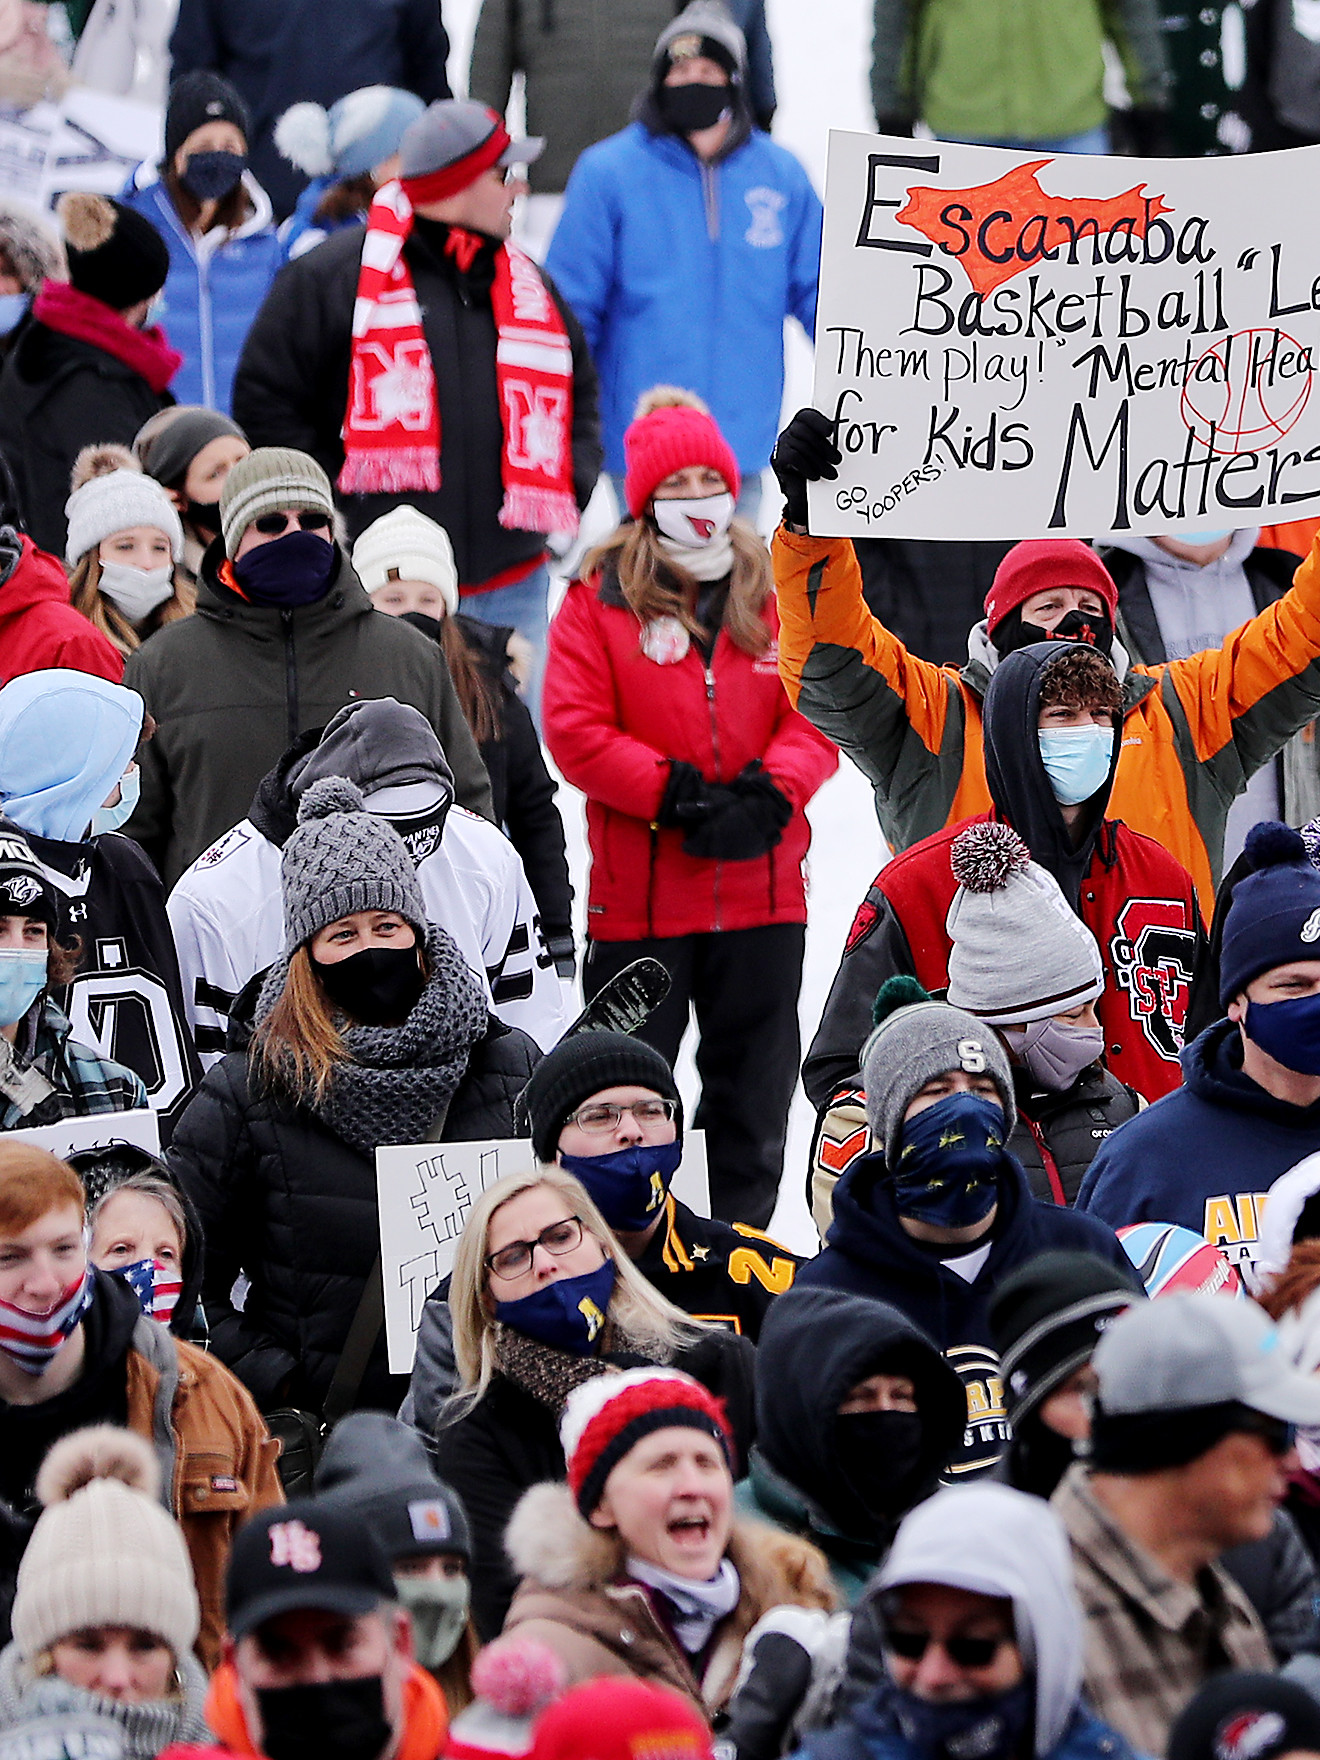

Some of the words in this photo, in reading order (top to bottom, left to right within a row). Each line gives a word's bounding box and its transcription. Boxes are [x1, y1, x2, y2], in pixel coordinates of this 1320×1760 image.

[855, 153, 1216, 265] Escanaba
[899, 264, 1229, 337] Basketball
[826, 327, 931, 381] Them
[1072, 335, 1234, 398] Mental
[832, 389, 898, 454] for
[923, 405, 1034, 471] Kids
[836, 486, 868, 510] GO
[857, 453, 947, 525] YOOPERS!
[957, 1039, 985, 1073] S
